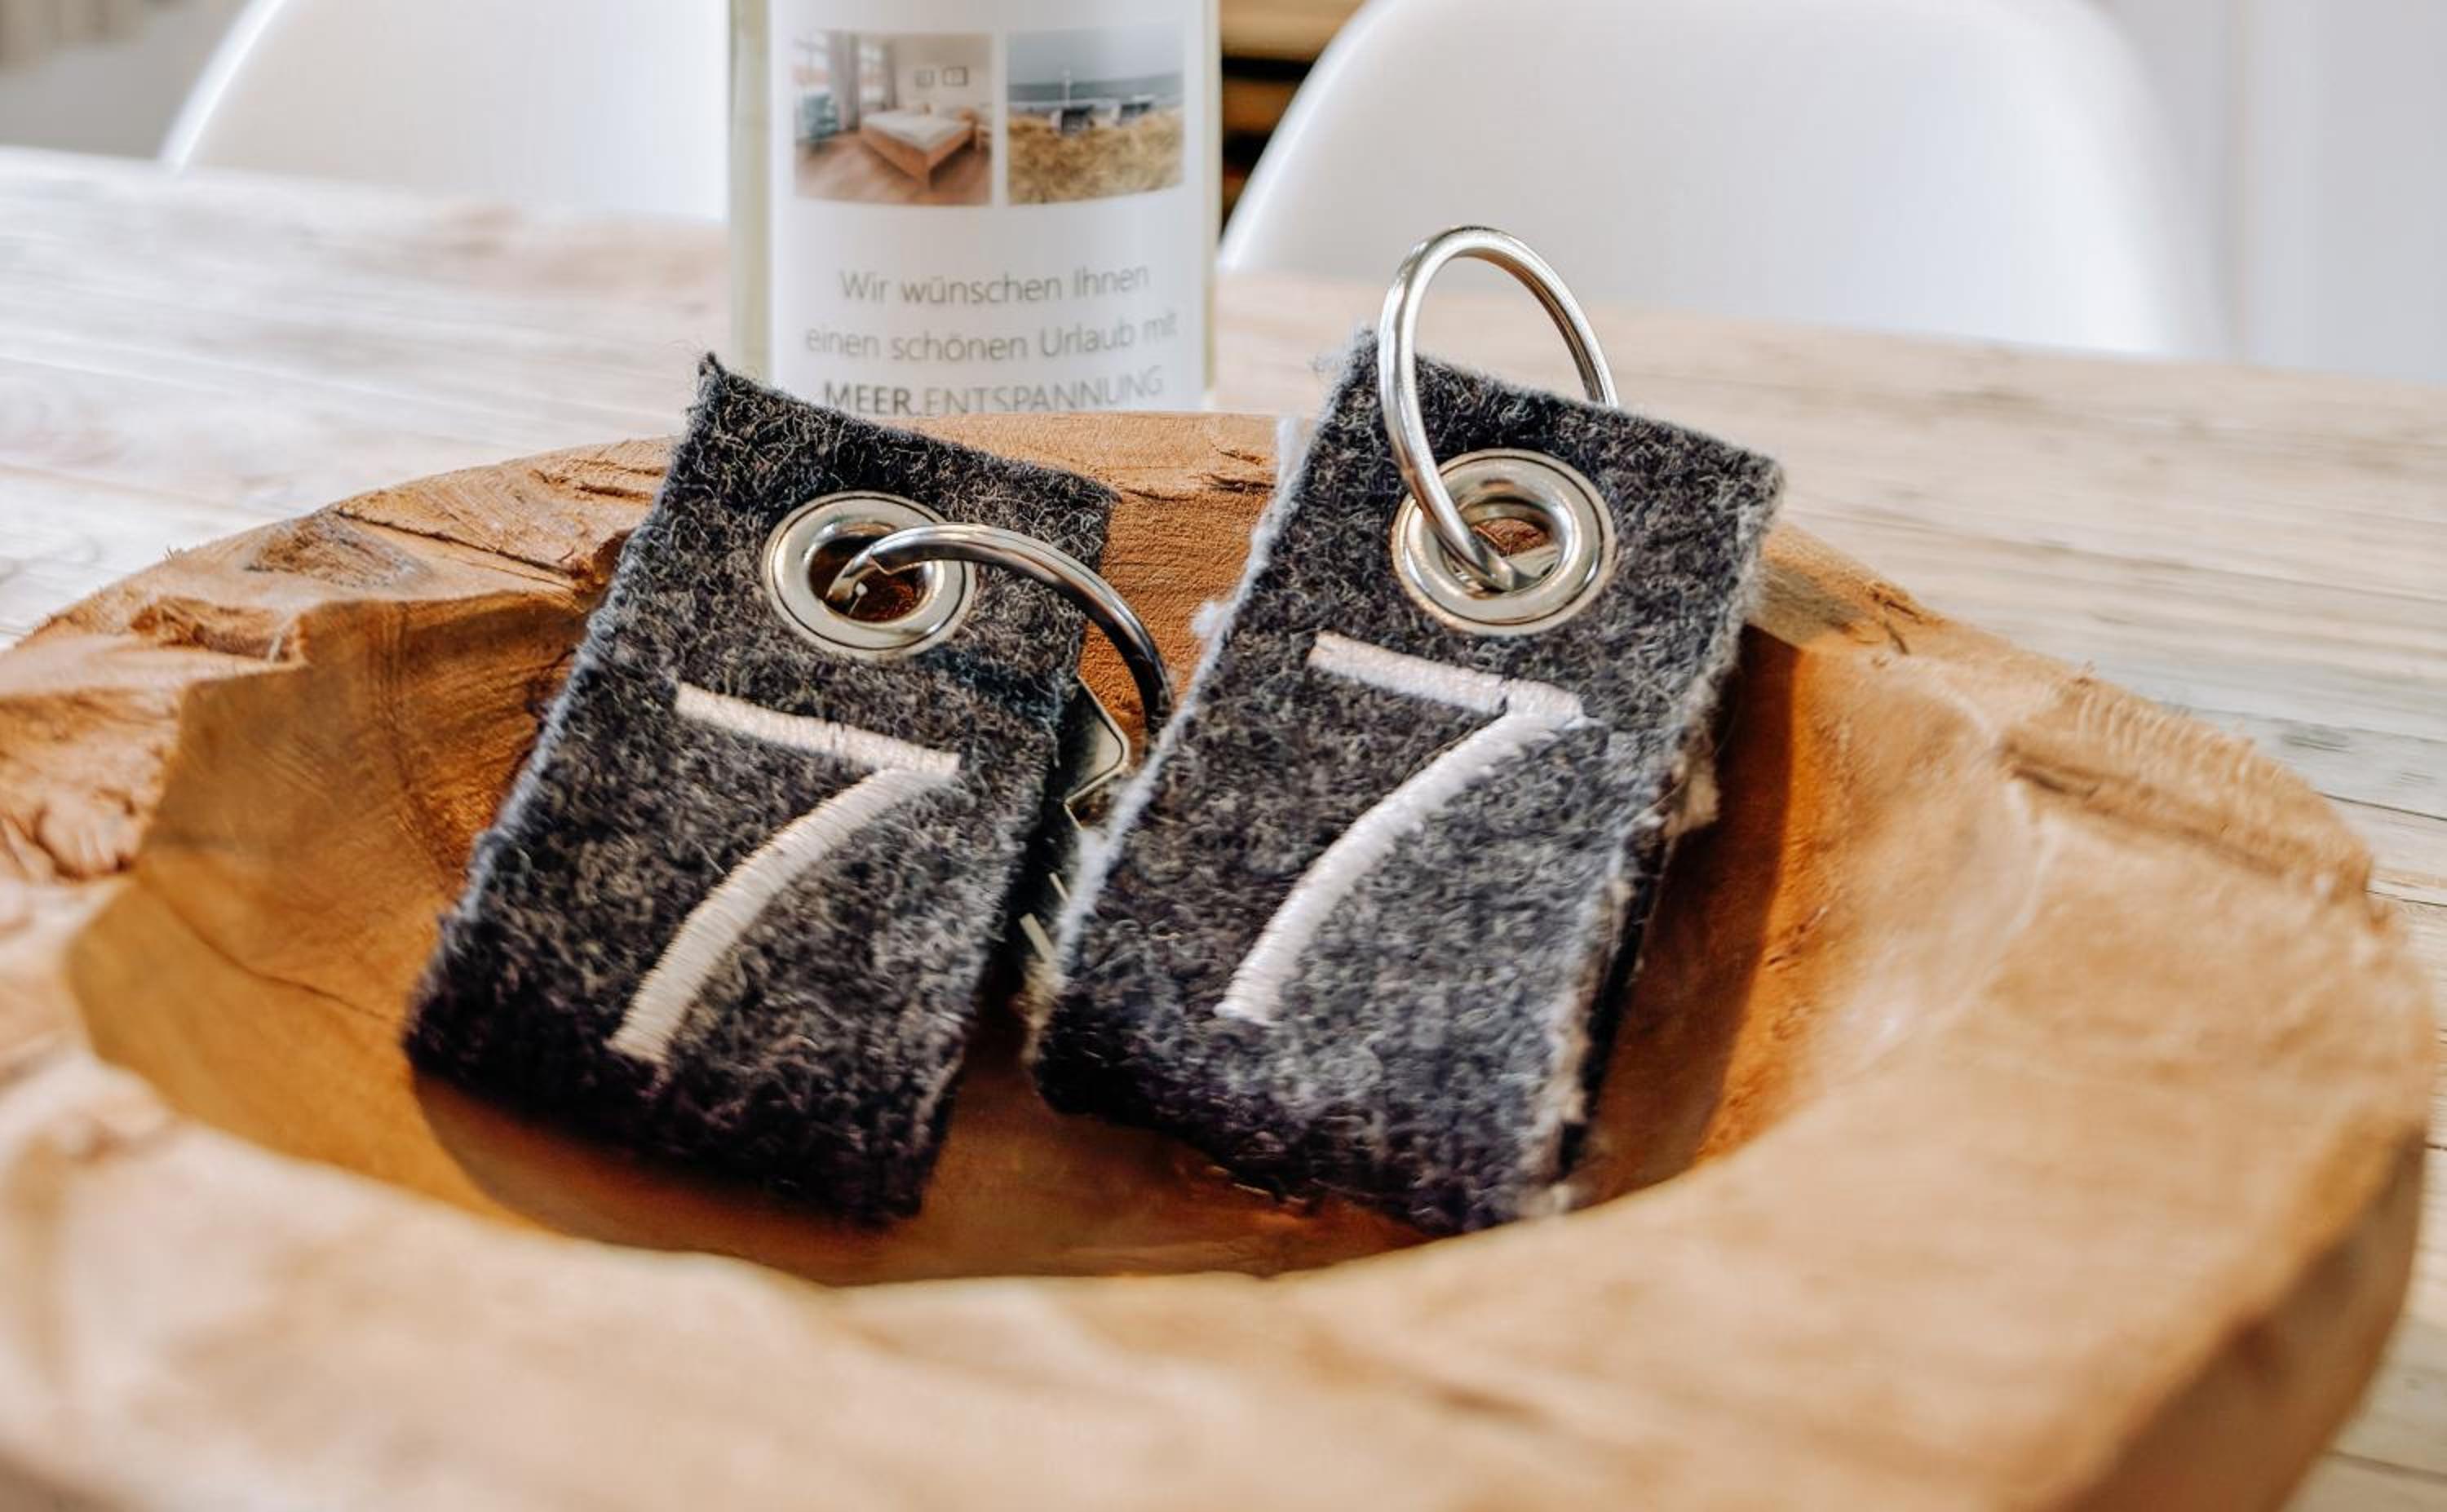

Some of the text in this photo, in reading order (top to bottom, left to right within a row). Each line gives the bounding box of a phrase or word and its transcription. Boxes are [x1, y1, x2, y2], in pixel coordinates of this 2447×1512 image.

[806, 312, 1179, 363] einen schönen Urlaub mit
[839, 263, 1150, 306] Wir wünschen Ihnen
[610, 683, 961, 1062] 7
[1213, 633, 1589, 1025] 7
